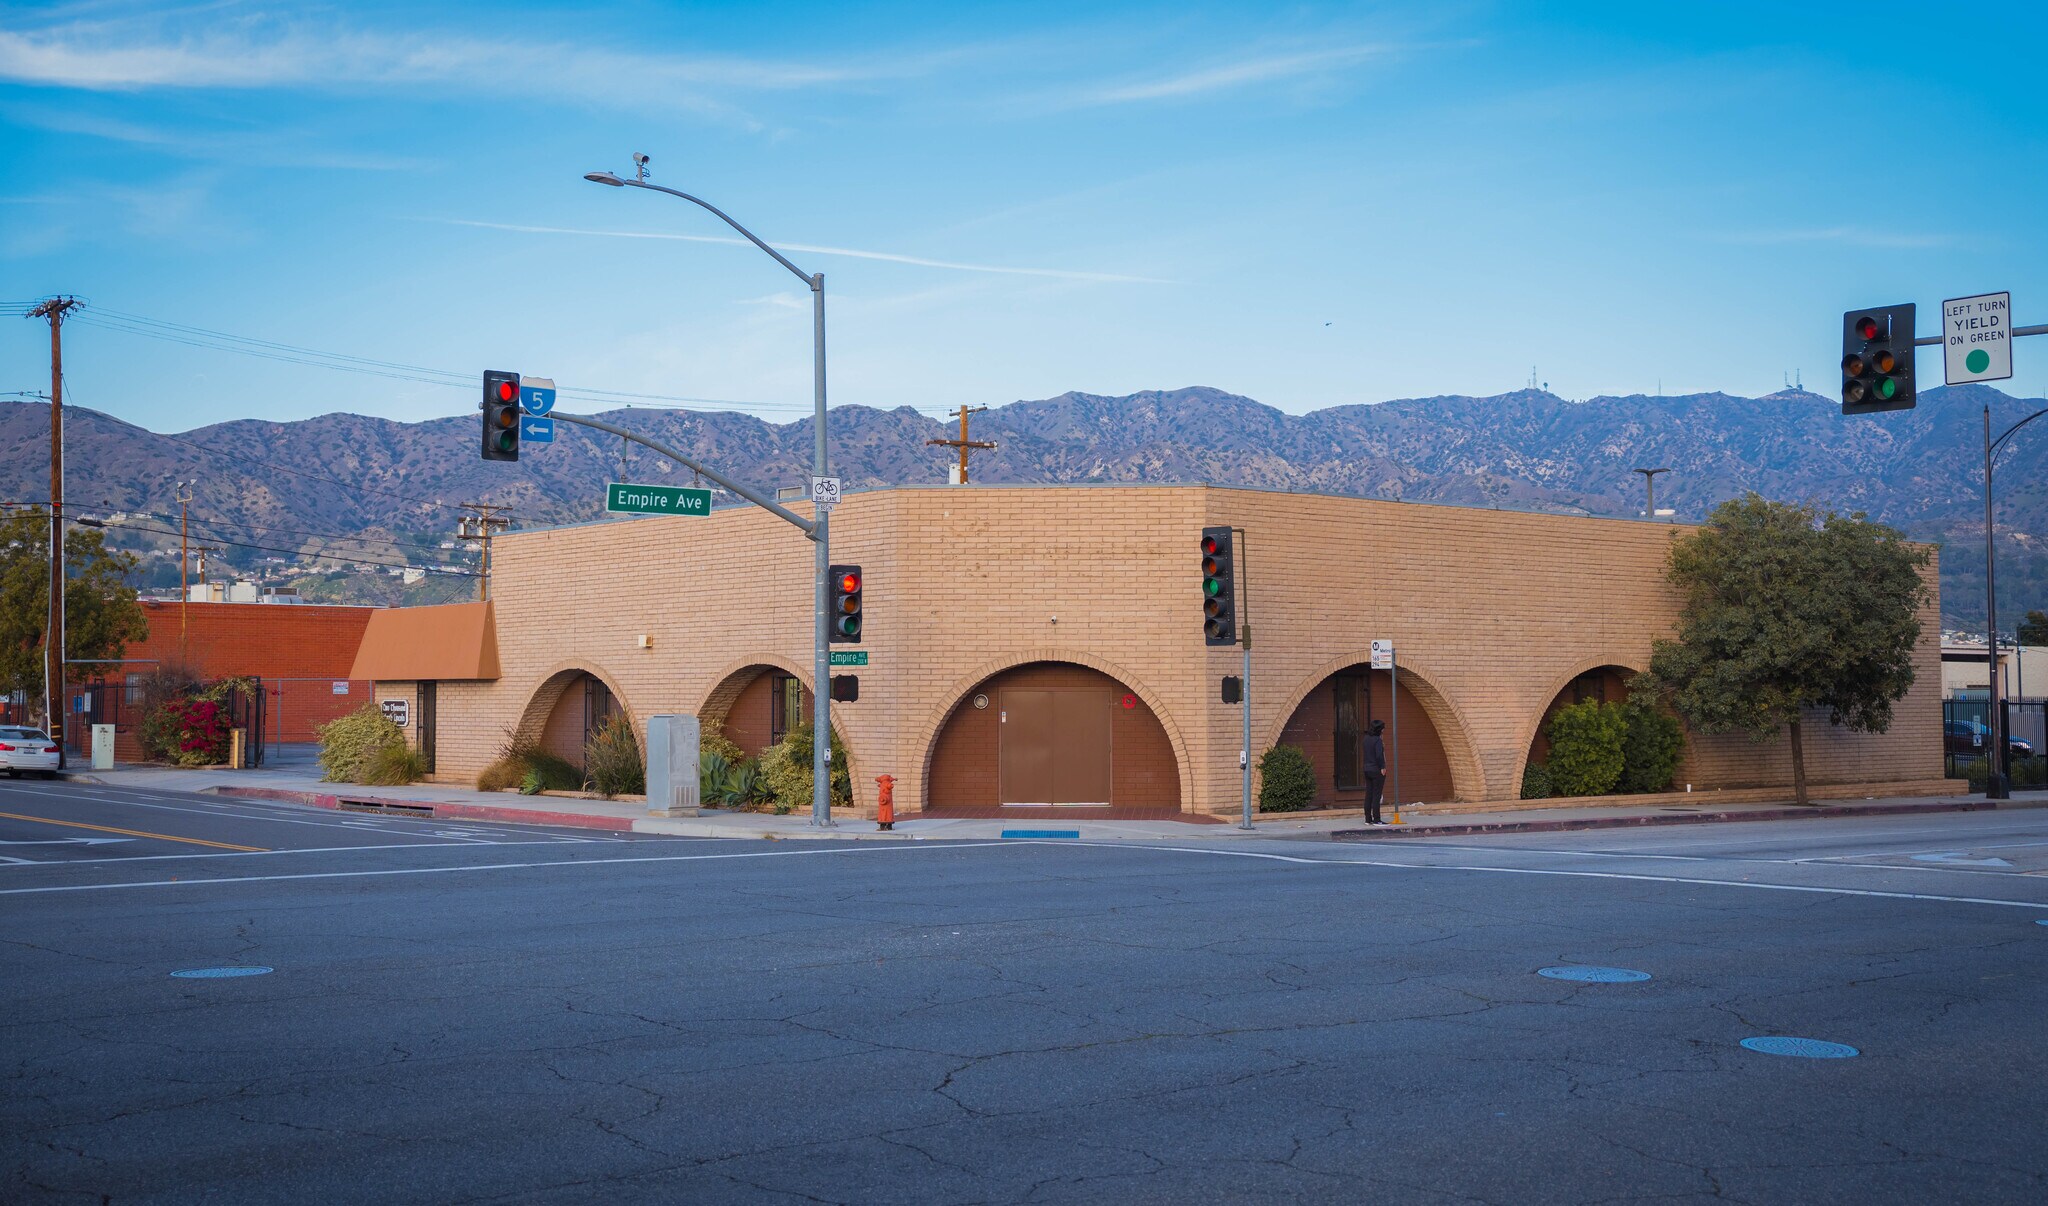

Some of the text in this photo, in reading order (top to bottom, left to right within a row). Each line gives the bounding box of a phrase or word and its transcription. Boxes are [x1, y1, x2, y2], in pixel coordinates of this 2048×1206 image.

[1946, 300, 2006, 317] LEFT TURN
[1954, 315, 1999, 331] YIELD
[1950, 330, 2005, 346] ON GREEN
[532, 391, 544, 410] 5
[618, 490, 702, 509] Empire Ave
[830, 652, 857, 664] Empire
